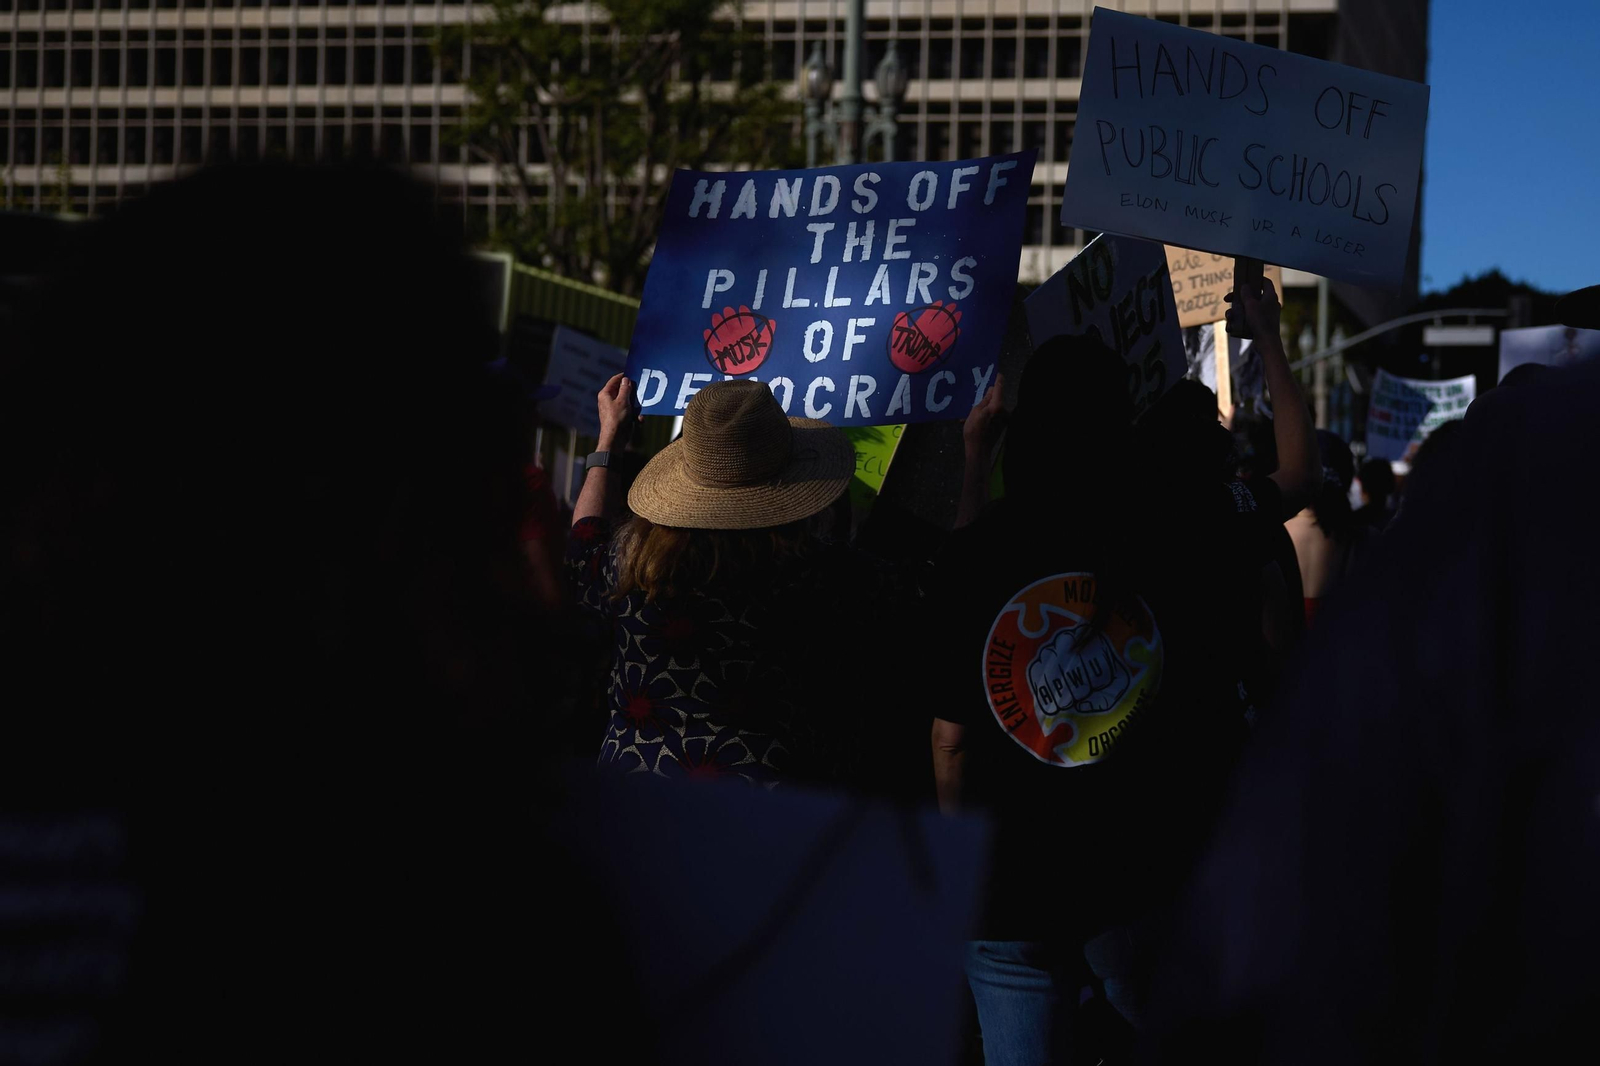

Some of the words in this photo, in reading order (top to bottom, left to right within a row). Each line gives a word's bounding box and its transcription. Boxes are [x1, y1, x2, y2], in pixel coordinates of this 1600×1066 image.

[1111, 36, 1277, 116] HANDS
[1314, 86, 1393, 139] OFF
[688, 172, 881, 219] HANDS
[906, 160, 1018, 212] OFF
[1096, 119, 1219, 188] PUBLIC
[1238, 143, 1397, 225] SCHOOLS
[805, 218, 916, 264] THE
[1120, 193, 1168, 212] ELON
[1185, 205, 1233, 228] MUSK
[1291, 226, 1302, 238] A
[1315, 229, 1366, 257] LOSER
[702, 256, 977, 309] PILLARS
[1068, 243, 1113, 325] NO
[716, 333, 767, 371] MUSK
[803, 318, 876, 363] OF
[894, 325, 944, 366] TRUMP
[637, 363, 995, 419] DEOCRACY
[989, 636, 1028, 731] ENERGIZE
[1038, 658, 1102, 705] APWU
